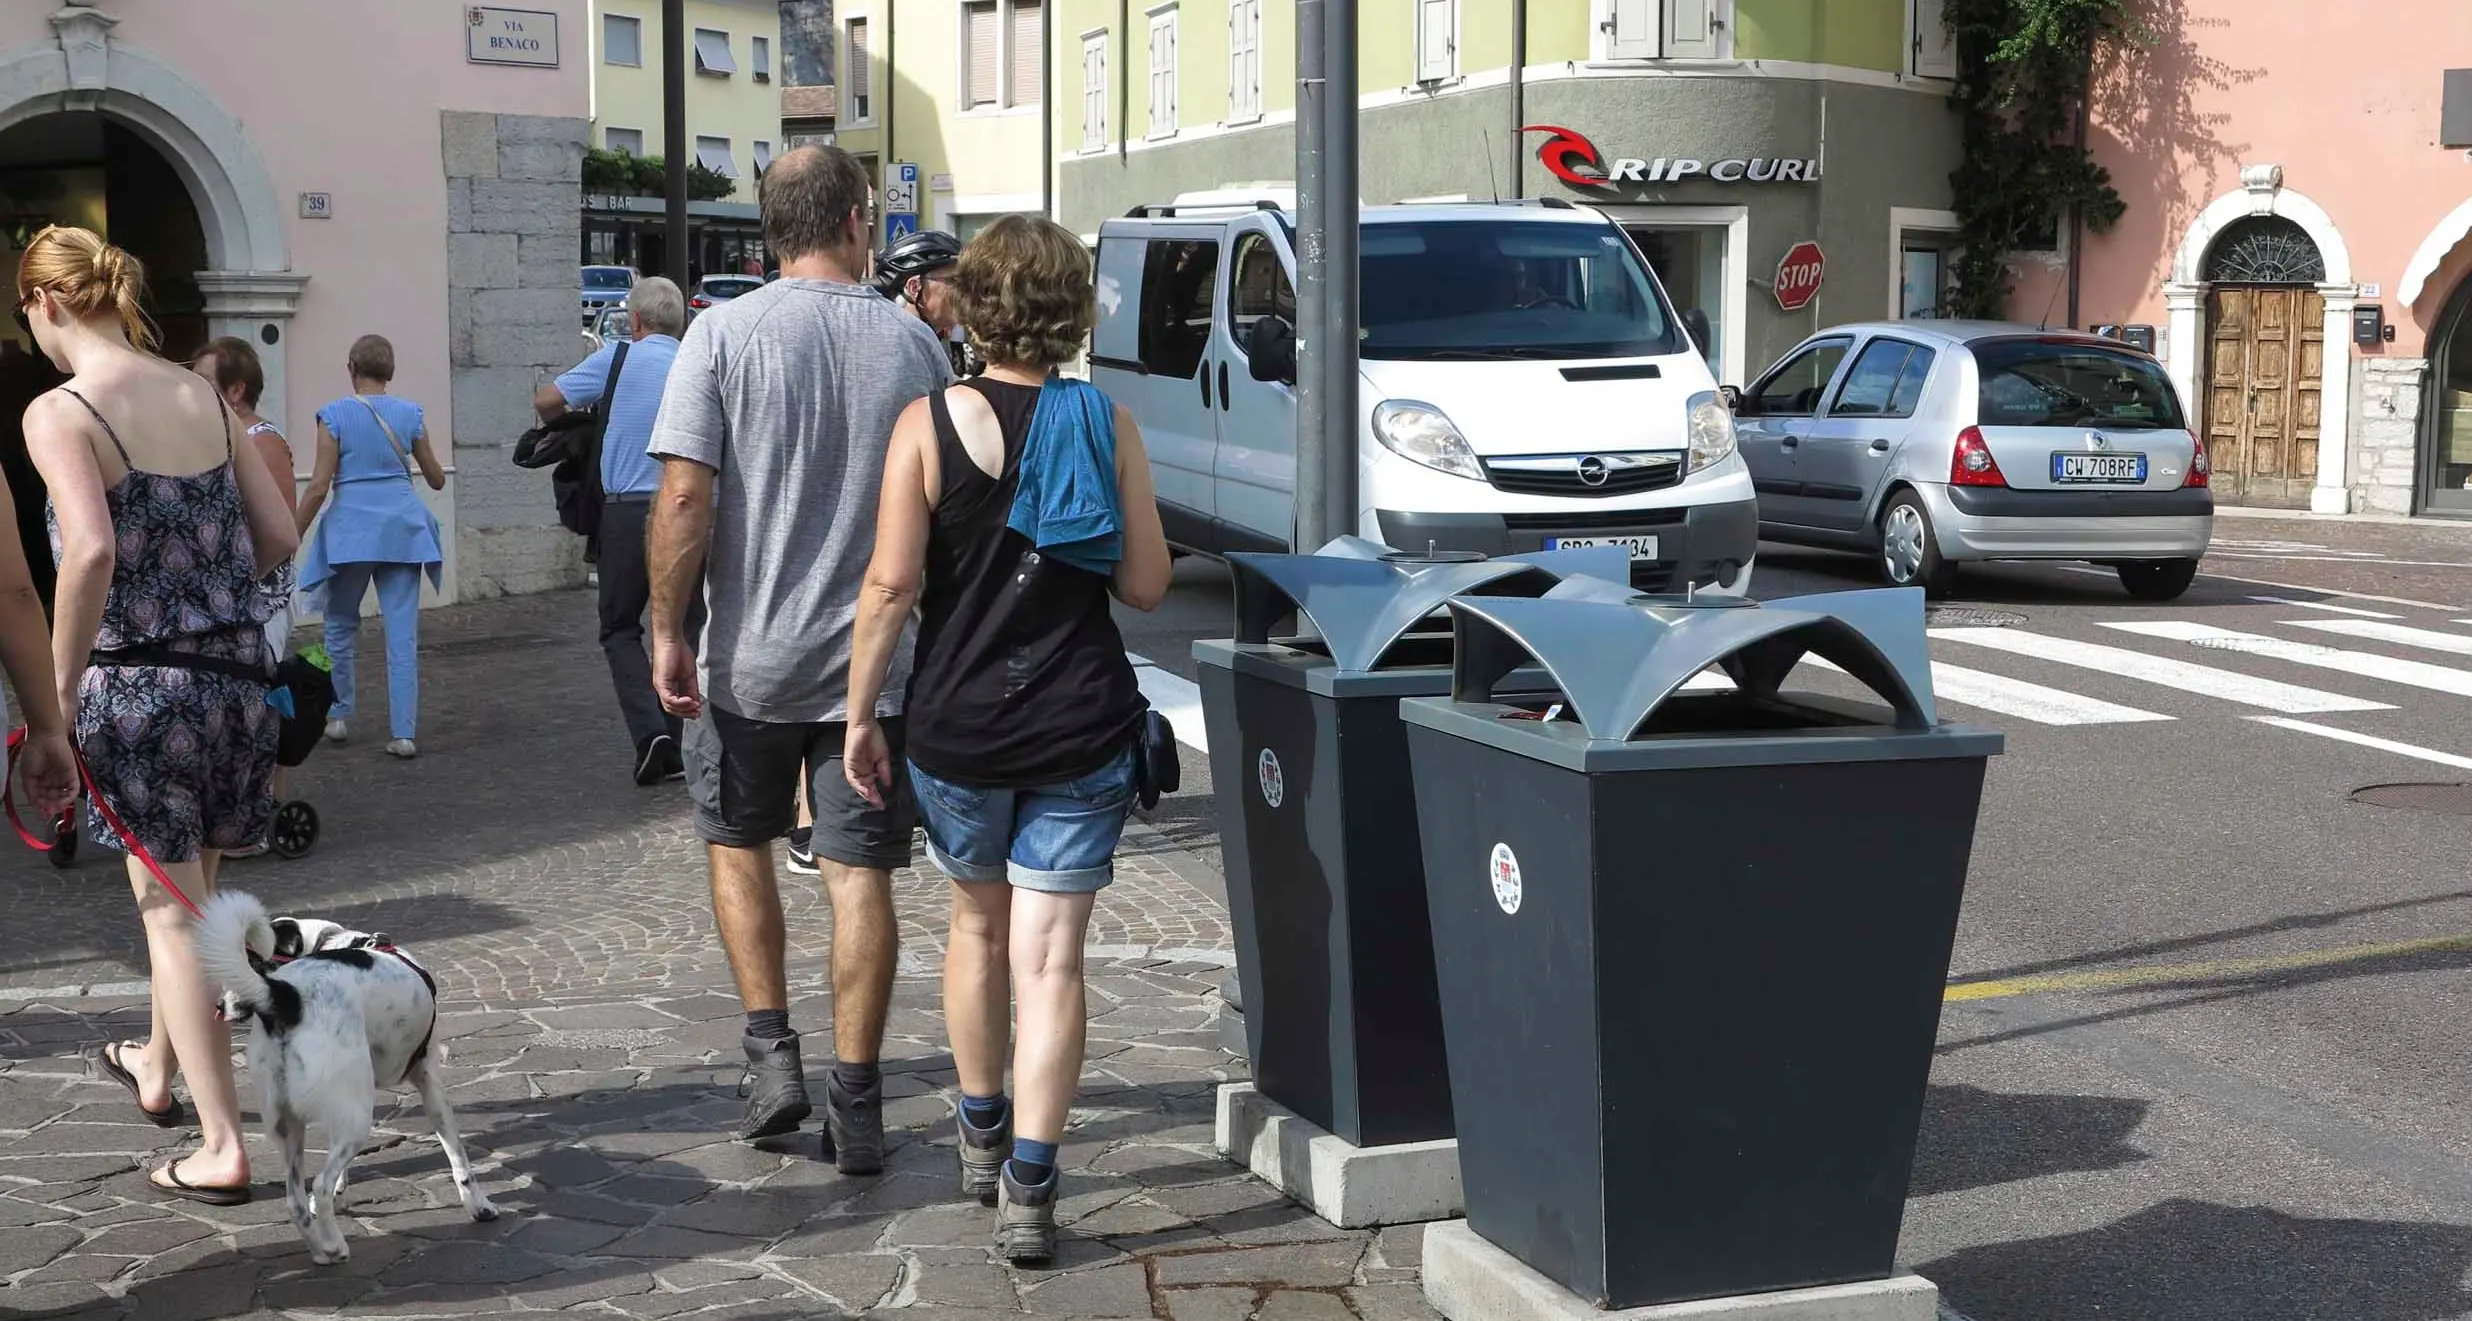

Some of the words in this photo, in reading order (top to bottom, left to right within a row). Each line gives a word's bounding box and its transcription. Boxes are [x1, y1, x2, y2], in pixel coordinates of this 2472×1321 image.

[503, 20, 524, 32] VIA
[490, 36, 540, 51] BENACO
[903, 167, 914, 181] P
[1608, 157, 1702, 181] RIP
[1710, 158, 1819, 182] CURL
[309, 195, 325, 211] 39
[609, 195, 631, 210] BAR
[1779, 262, 1821, 290] STOP
[2065, 458, 2083, 476] CW
[2089, 459, 2136, 477] 708RF
